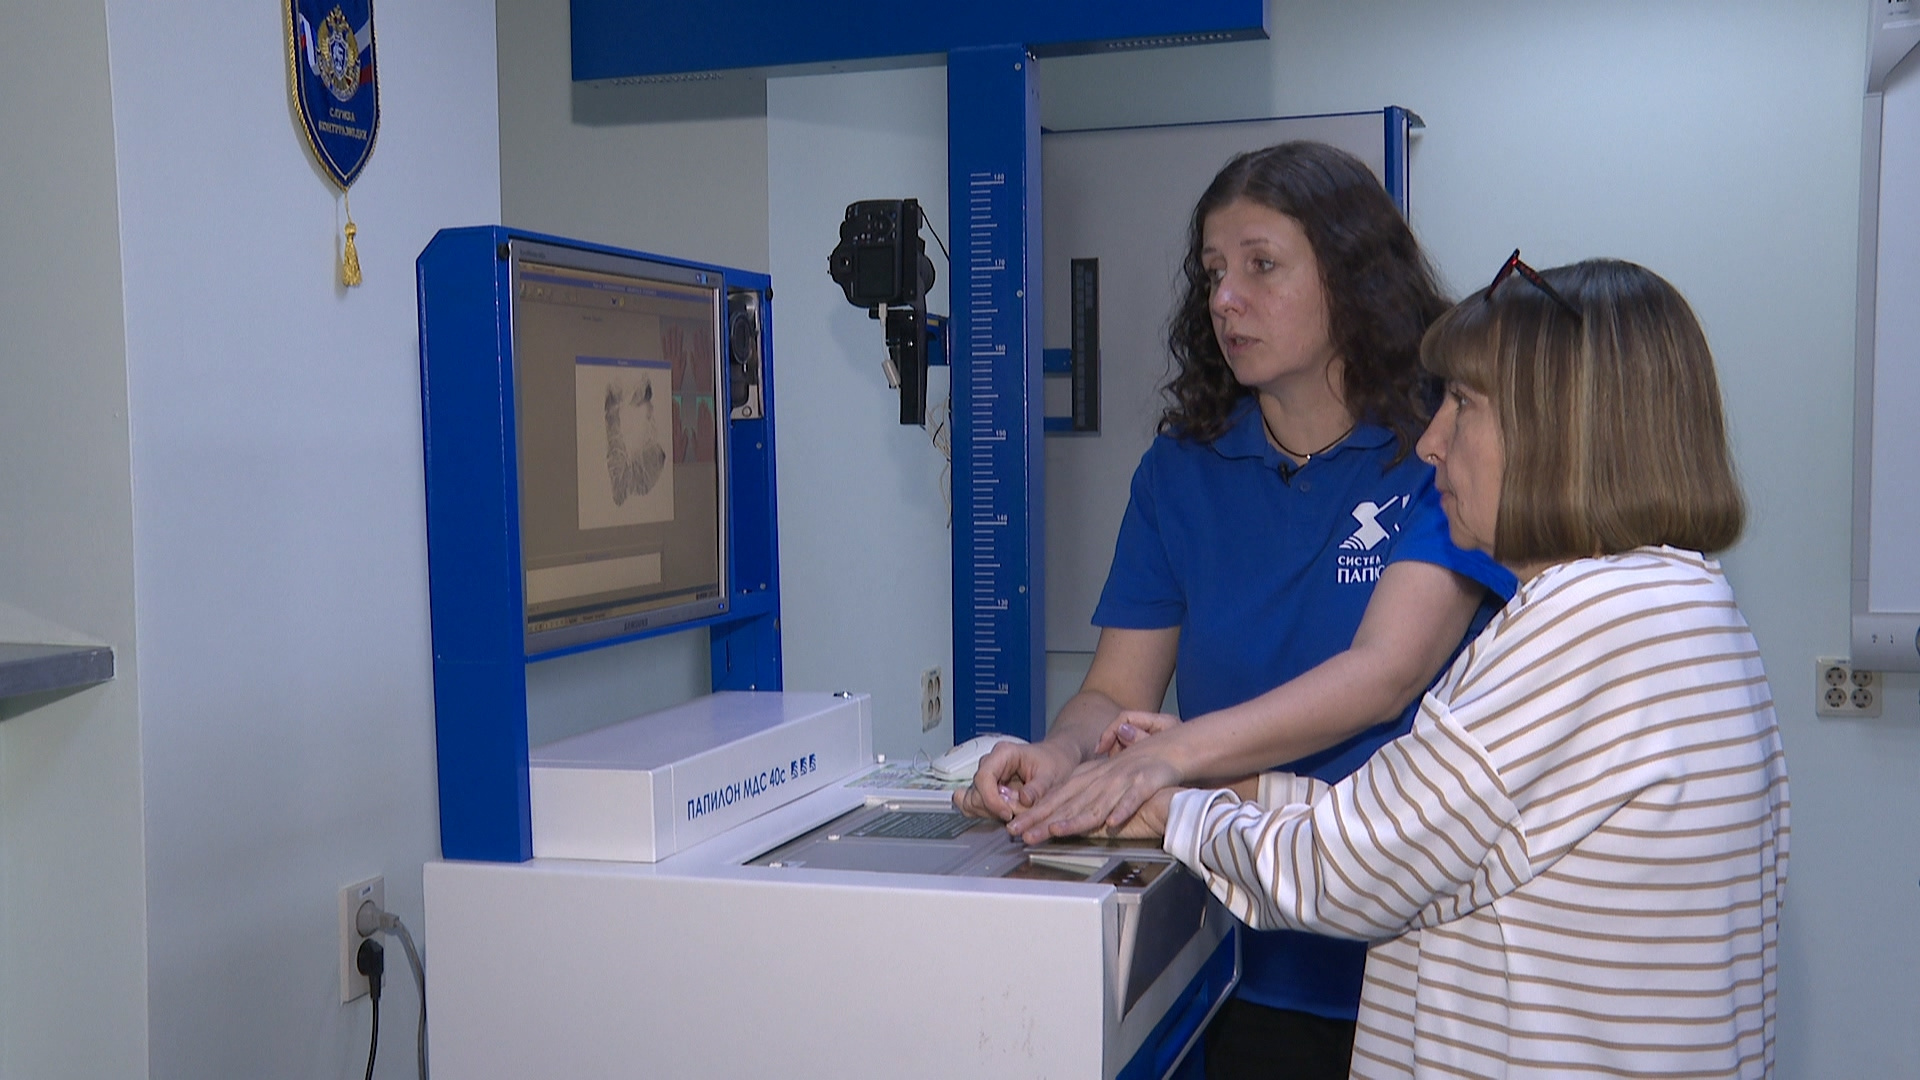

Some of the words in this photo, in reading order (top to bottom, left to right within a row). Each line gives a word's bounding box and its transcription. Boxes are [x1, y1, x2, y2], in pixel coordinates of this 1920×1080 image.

[329, 107, 356, 122] СЛУЖБА
[994, 259, 1006, 267] 170
[996, 514, 1008, 522] 140
[997, 599, 1009, 607] 130
[687, 781, 741, 821] ПАПИЛОН
[743, 772, 767, 799] МДС
